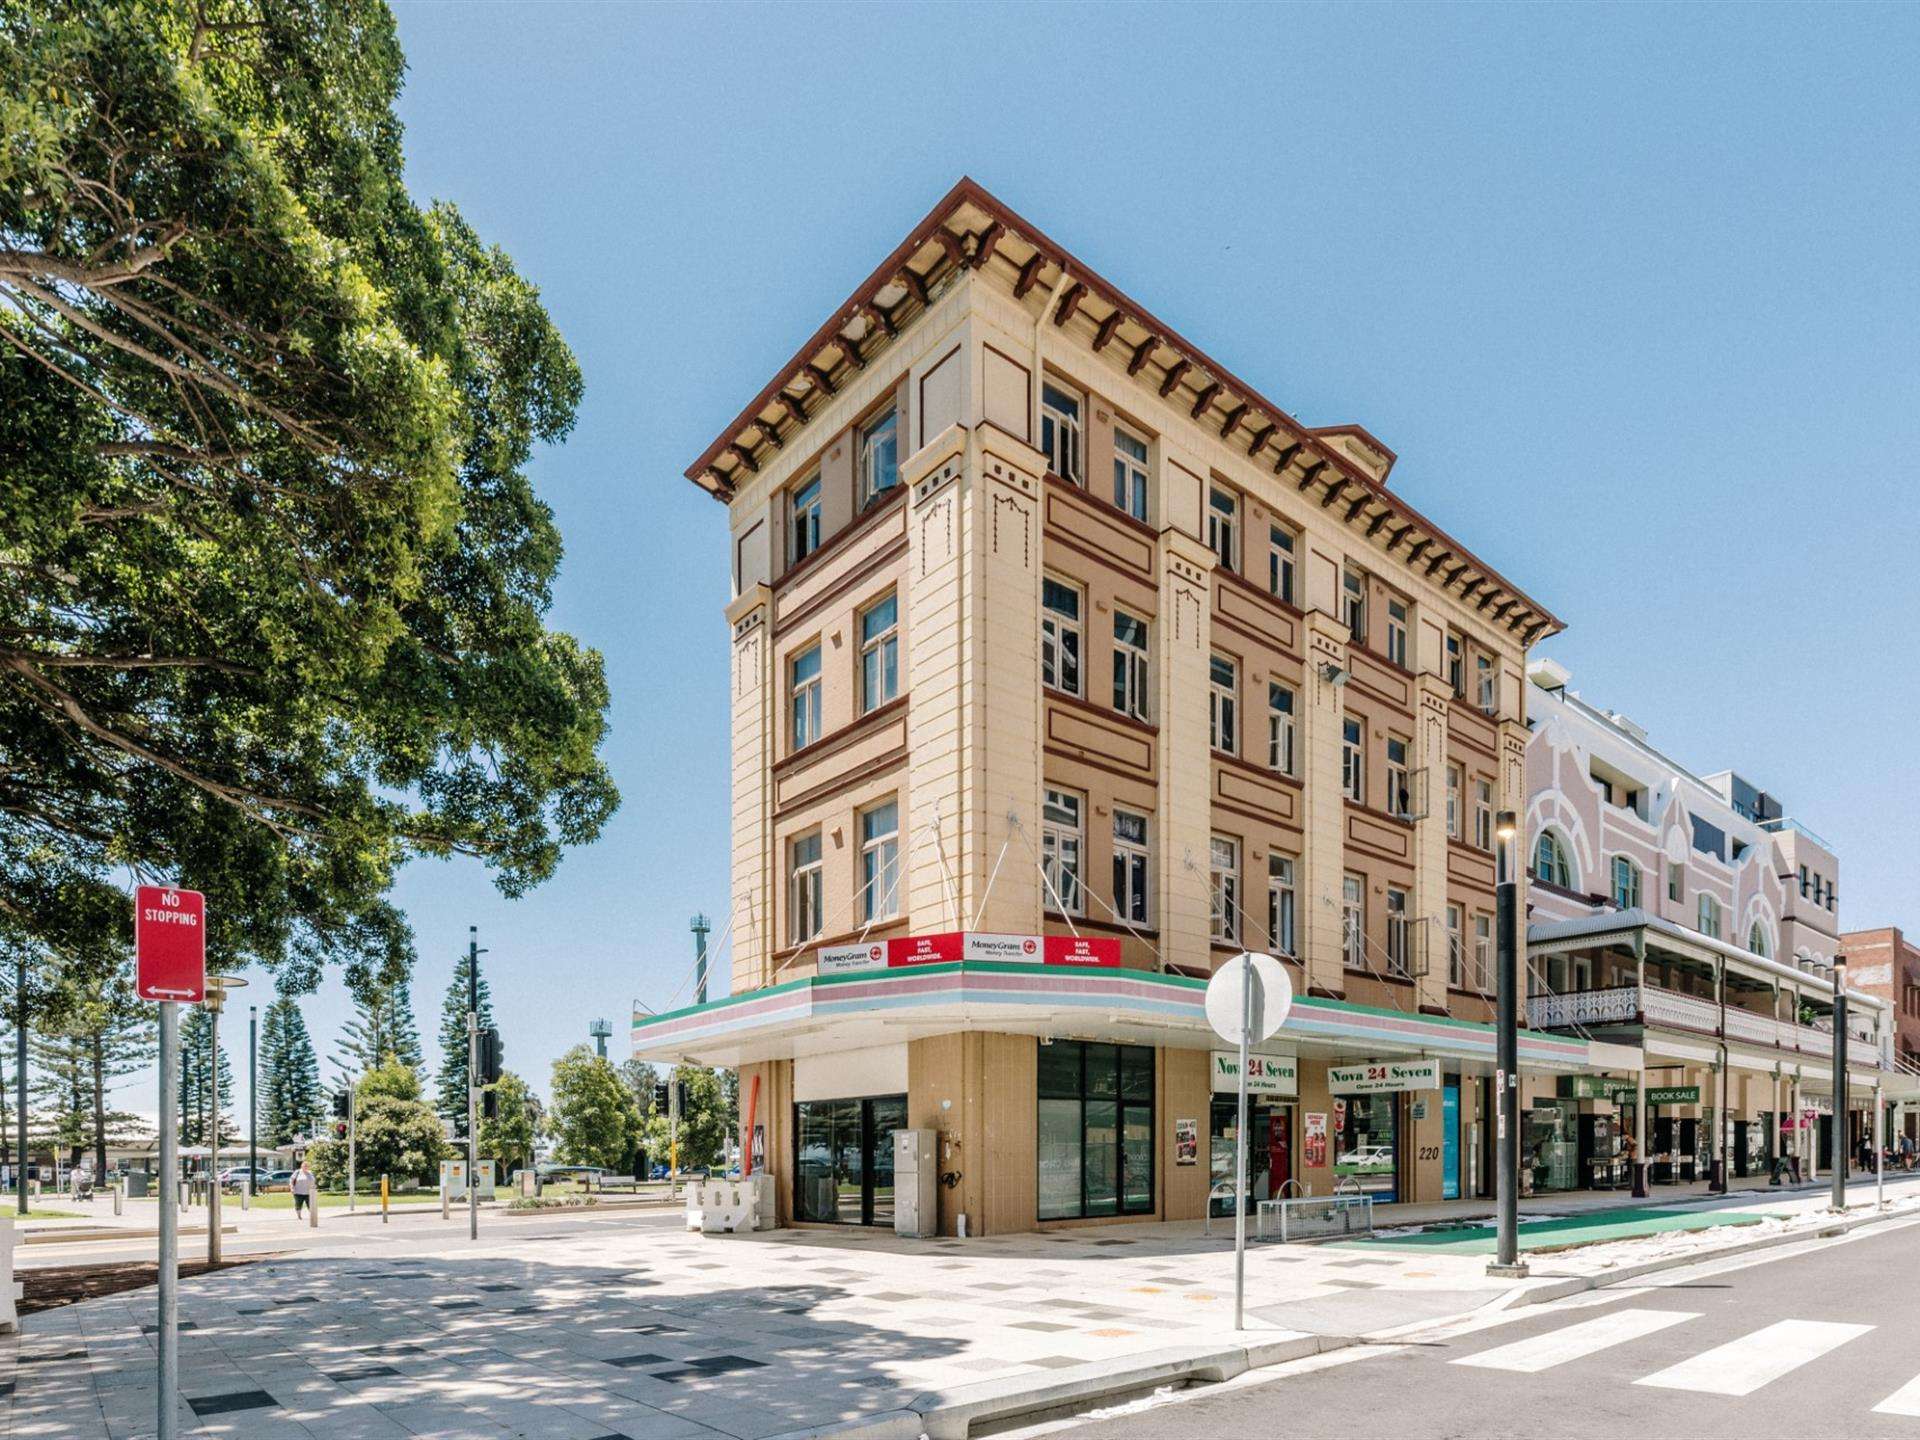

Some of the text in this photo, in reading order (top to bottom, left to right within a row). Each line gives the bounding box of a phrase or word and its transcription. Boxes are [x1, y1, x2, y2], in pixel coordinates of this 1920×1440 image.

[161, 893, 180, 907] NO
[145, 908, 197, 925] STOPPING
[972, 940, 1020, 951] MoneyGram
[823, 952, 868, 963] MoneyGram
[1217, 1057, 1295, 1078] Nov 24 Seven
[1331, 1066, 1432, 1082] Nova 24 Seven
[1651, 1090, 1696, 1101] BOOK SALE
[1419, 1146, 1439, 1160] 220
